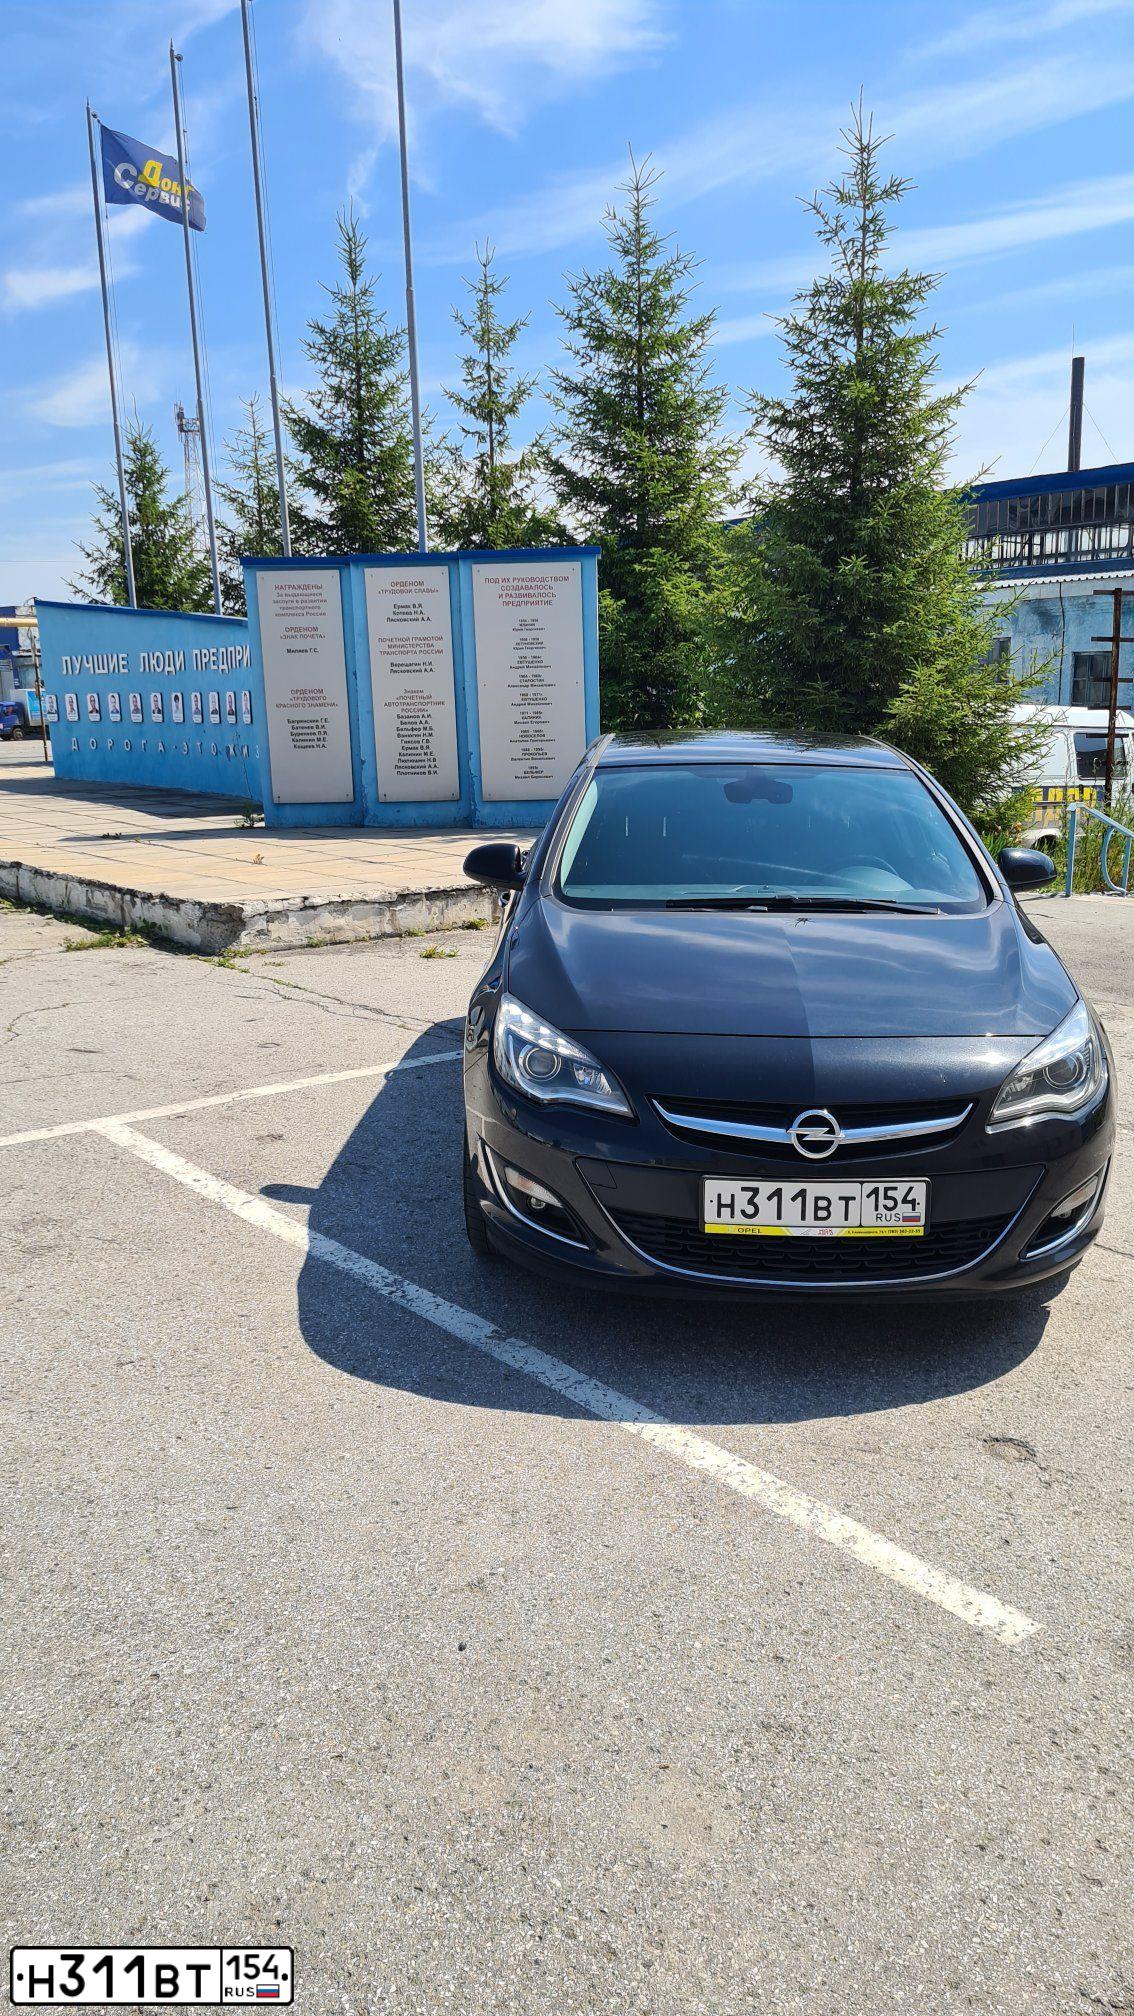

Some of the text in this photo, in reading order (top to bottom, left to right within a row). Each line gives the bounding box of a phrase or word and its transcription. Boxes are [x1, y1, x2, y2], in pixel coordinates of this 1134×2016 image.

[390, 580, 425, 588] ОРДЕНОМ
[484, 577, 501, 585] ПОД
[511, 575, 570, 583] РУКОВОДСТВОМ
[500, 584, 554, 592] СОЗДАВАЛОСЬ
[504, 591, 558, 599] РАЗВИВАЛОСЬ
[502, 599, 554, 607] ПРЕДПРИЯТИЕ
[284, 626, 319, 634] ОРДЕНОМ
[61, 645, 250, 675] ЛУЧШИЕ ЛЮДИ ПРЕДПРИ
[716, 1186, 917, 1221] Н311ВТ 154
[875, 1212, 902, 1222] RUS
